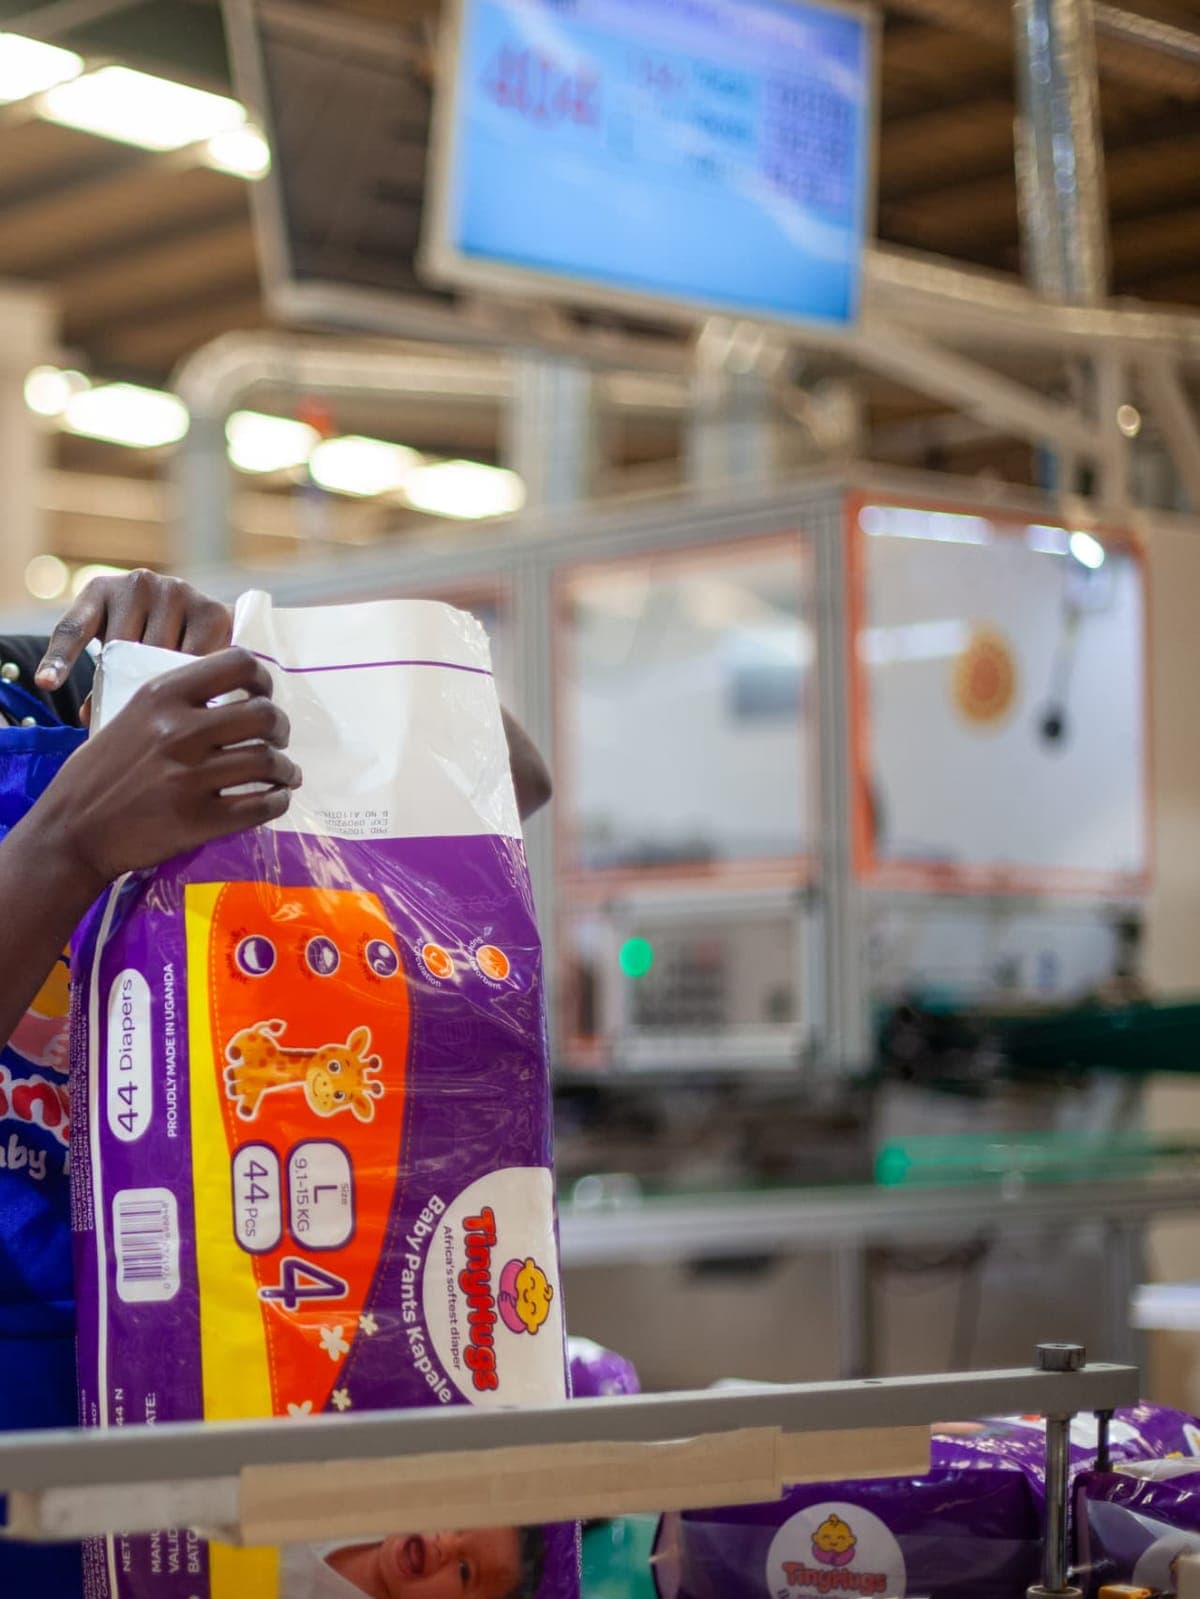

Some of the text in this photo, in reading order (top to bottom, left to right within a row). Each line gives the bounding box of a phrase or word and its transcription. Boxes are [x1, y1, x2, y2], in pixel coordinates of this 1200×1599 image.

[117, 979, 138, 1132] 44 Diapers
[163, 963, 177, 1137] PROUDLY MADE IN UGANDA
[243, 1160, 270, 1204] 44
[294, 1158, 310, 1232] 9.1-15 KG
[313, 1185, 338, 1204] L
[340, 1183, 349, 1205] Size
[259, 1257, 348, 1310] 4
[401, 1195, 452, 1404] Baby Pants Kapale
[443, 1226, 461, 1370] Africa's softest diaper
[458, 1206, 499, 1391] TinyHugs
[121, 1540, 131, 1572] NET
[782, 1561, 888, 1597] TinyHugs
